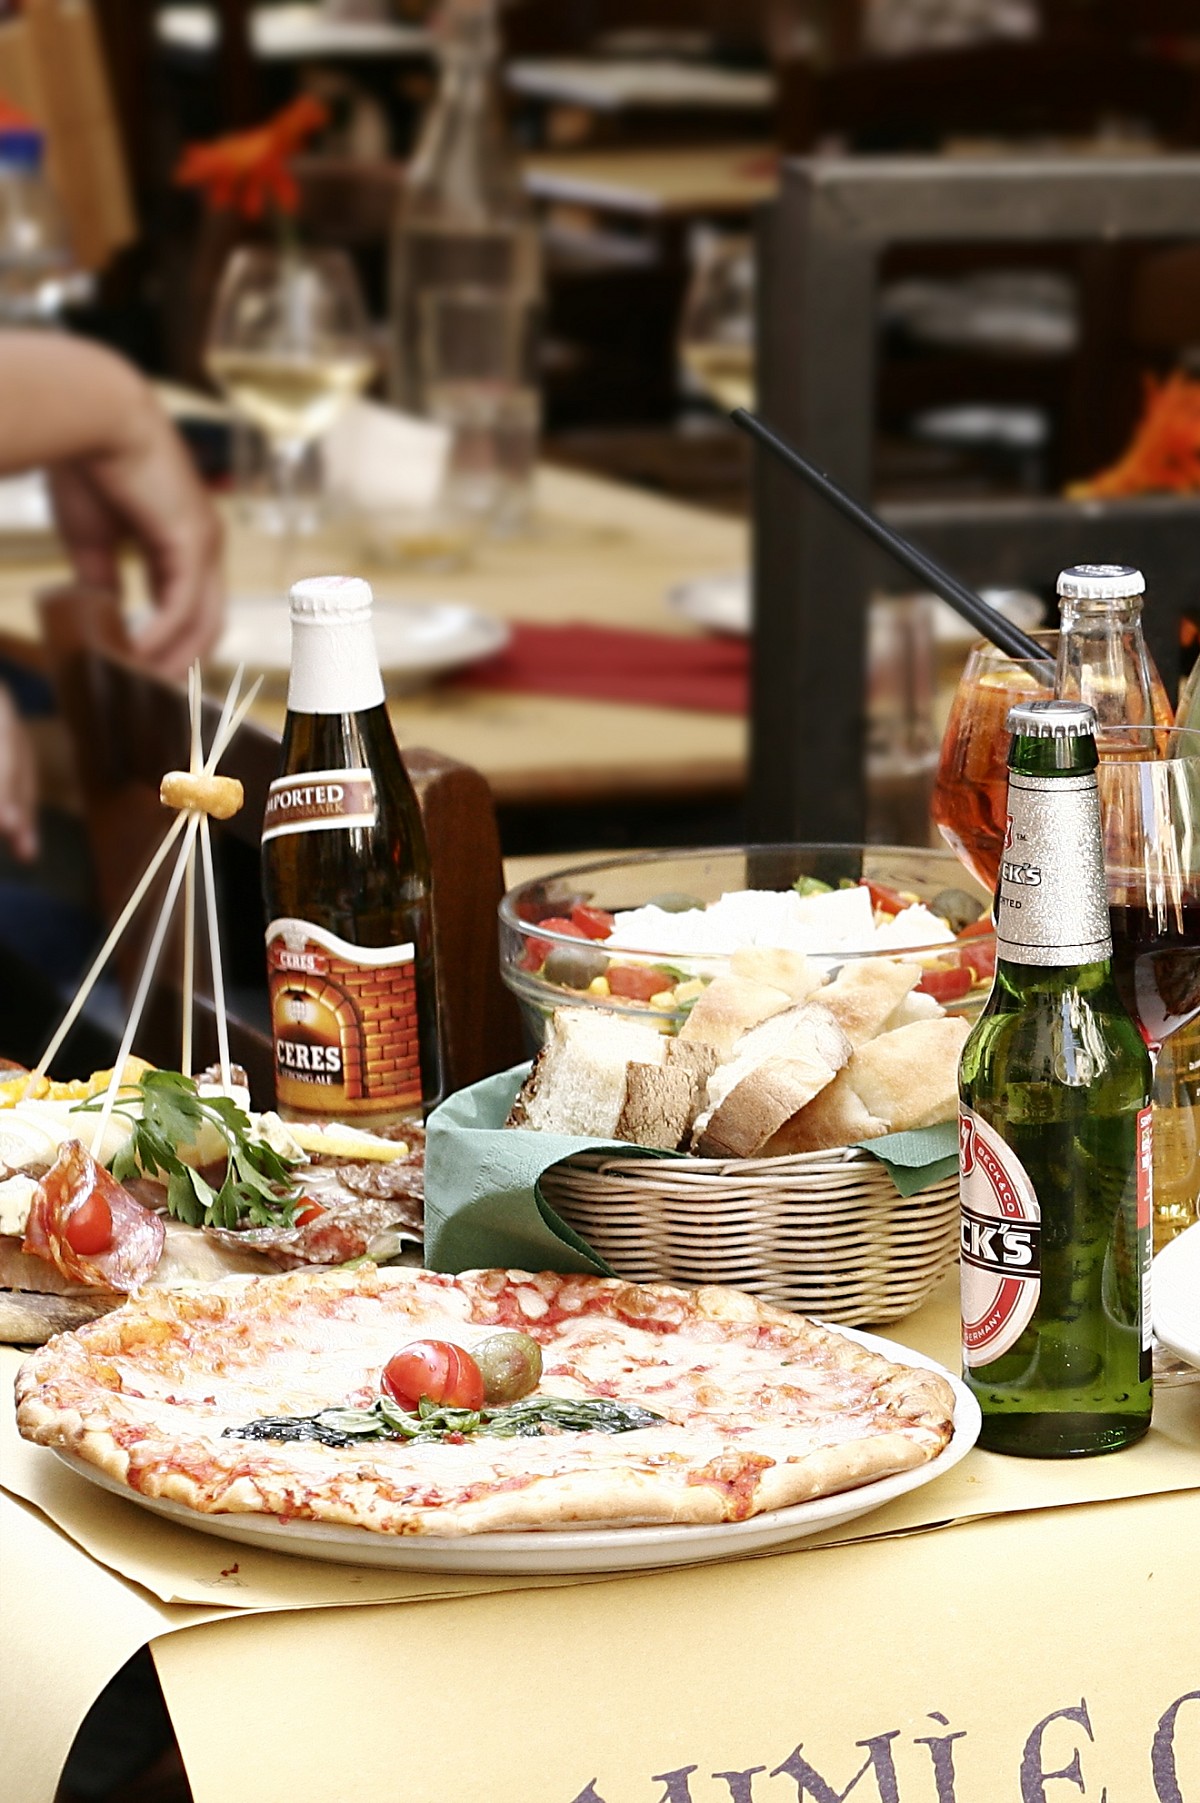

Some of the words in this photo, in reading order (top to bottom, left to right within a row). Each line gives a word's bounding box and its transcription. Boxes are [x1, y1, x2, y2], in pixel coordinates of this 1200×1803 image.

[1001, 861, 1042, 886] CK'S
[280, 952, 315, 970] CERES
[276, 1039, 341, 1072] CERES
[961, 1215, 1033, 1266] CK'S
